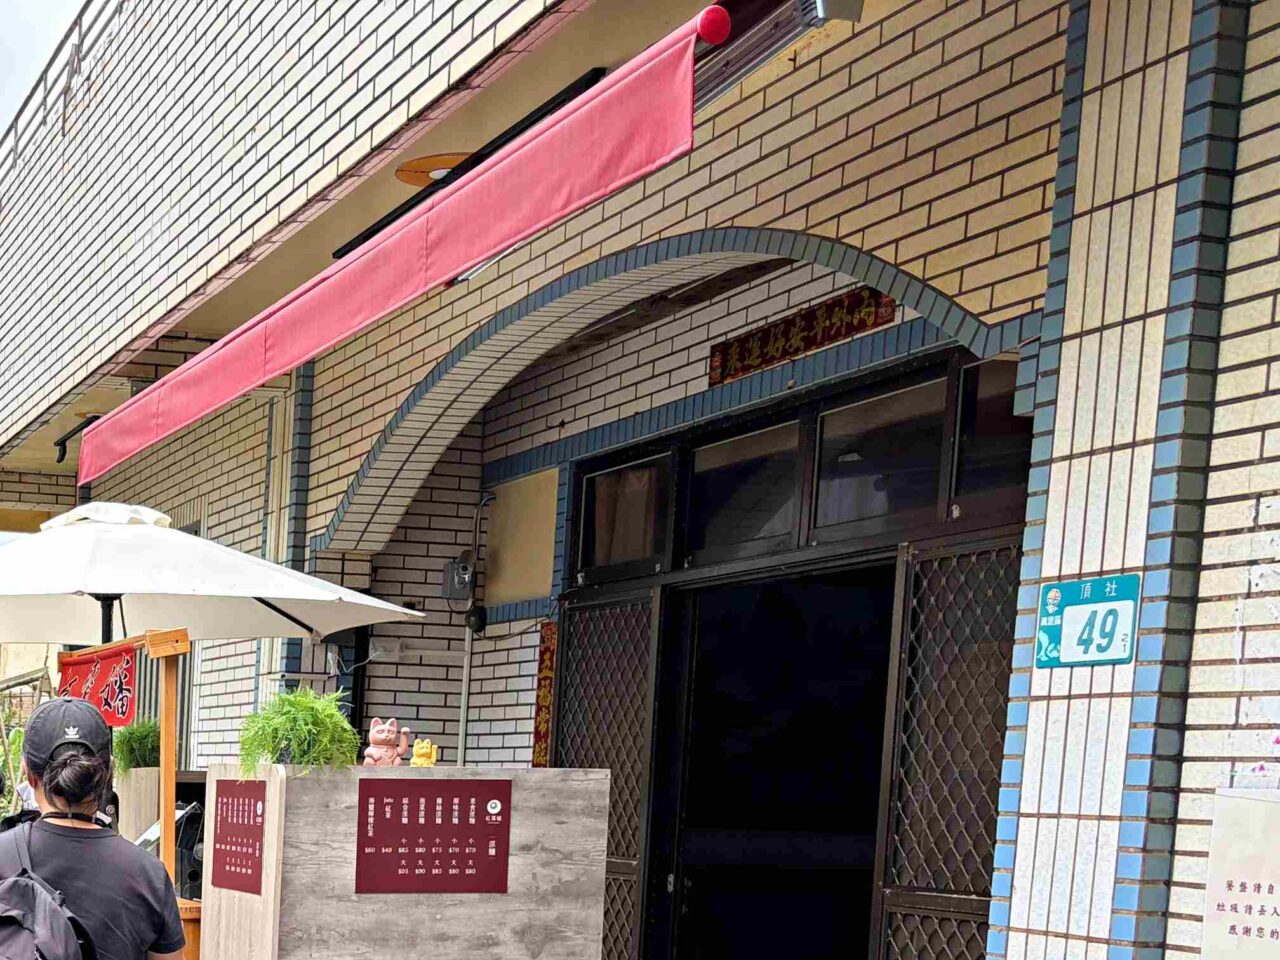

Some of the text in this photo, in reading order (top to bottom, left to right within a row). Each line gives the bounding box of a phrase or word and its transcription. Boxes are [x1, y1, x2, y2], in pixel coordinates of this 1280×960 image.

[1080, 580, 1118, 600] 頂社
[1076, 608, 1119, 654] 49
[1228, 925, 1280, 940] 感謝您的
